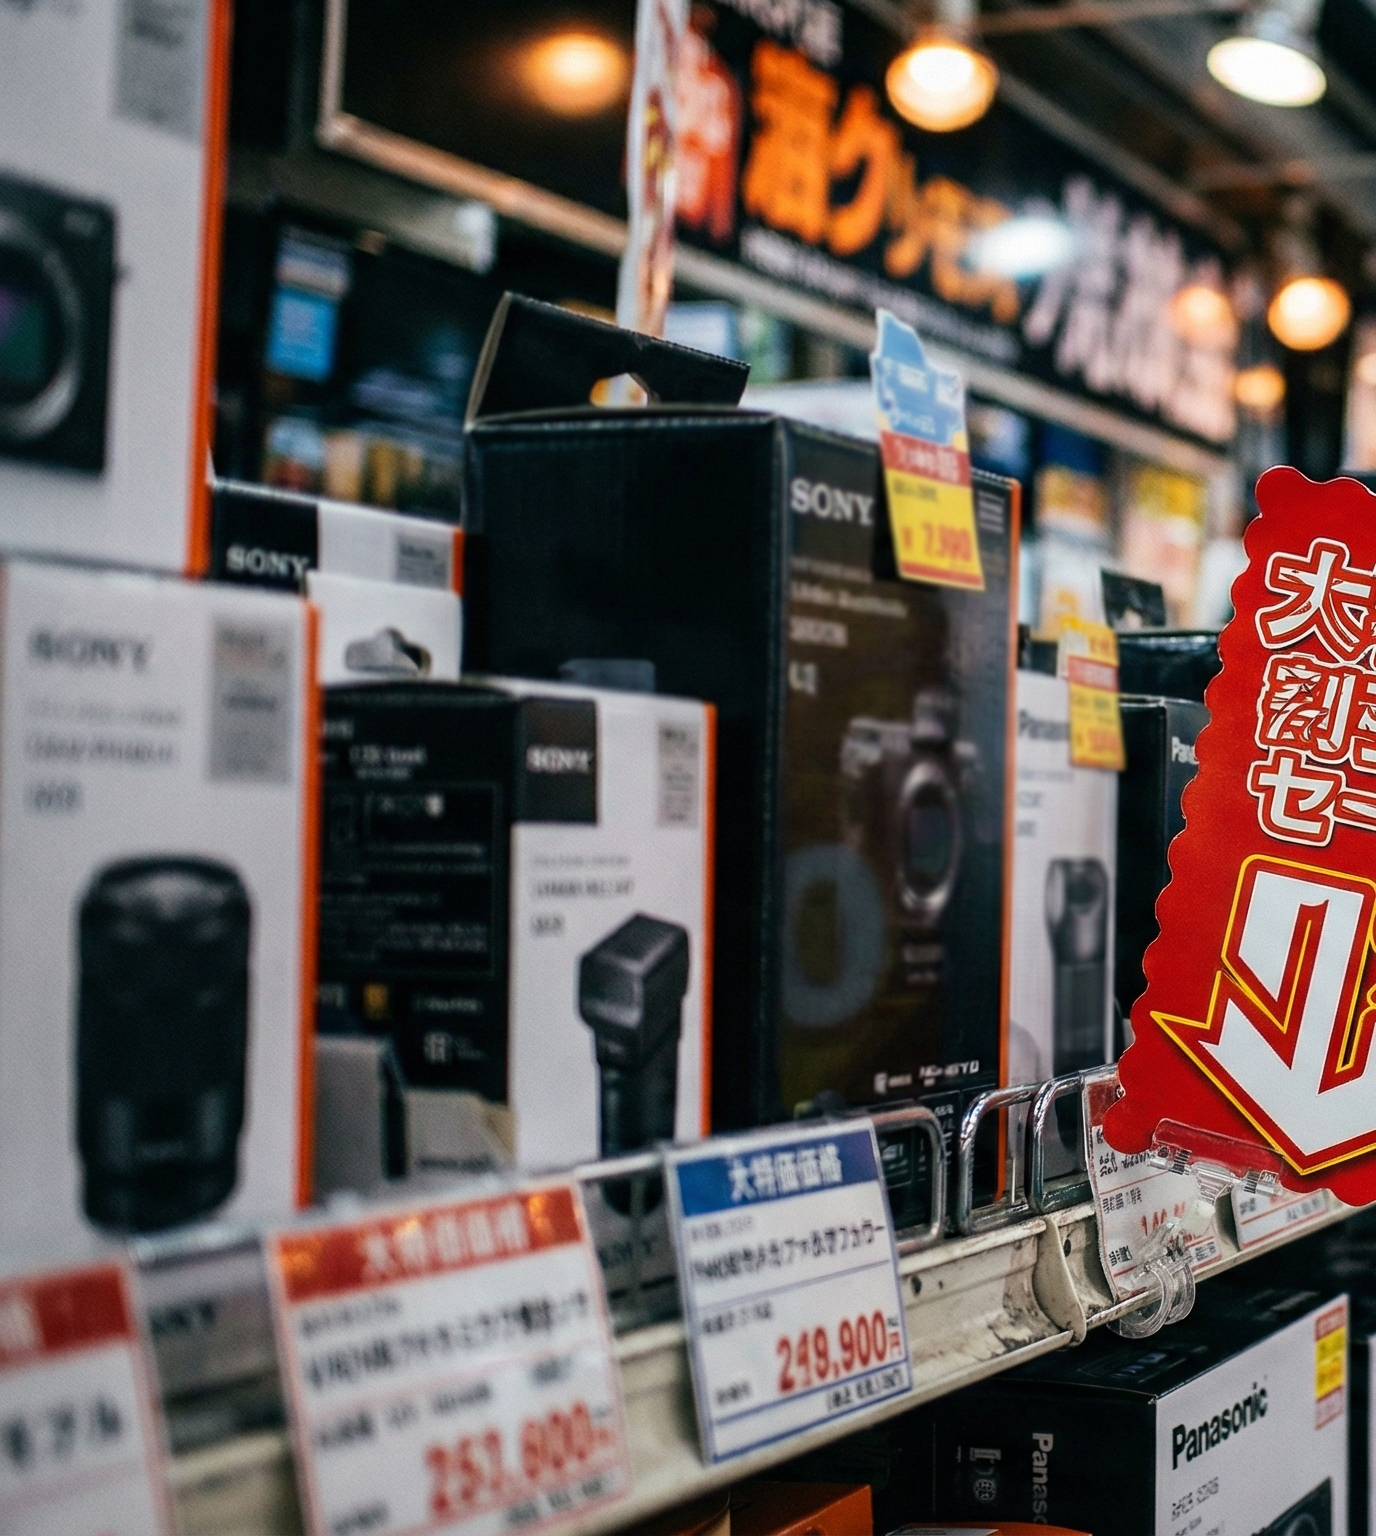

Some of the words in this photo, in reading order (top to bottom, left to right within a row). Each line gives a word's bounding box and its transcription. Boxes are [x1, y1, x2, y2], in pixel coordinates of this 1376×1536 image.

[790, 477, 873, 526] SONY
[226, 545, 309, 576] SONY
[1172, 1381, 1268, 1470] Panasonic
